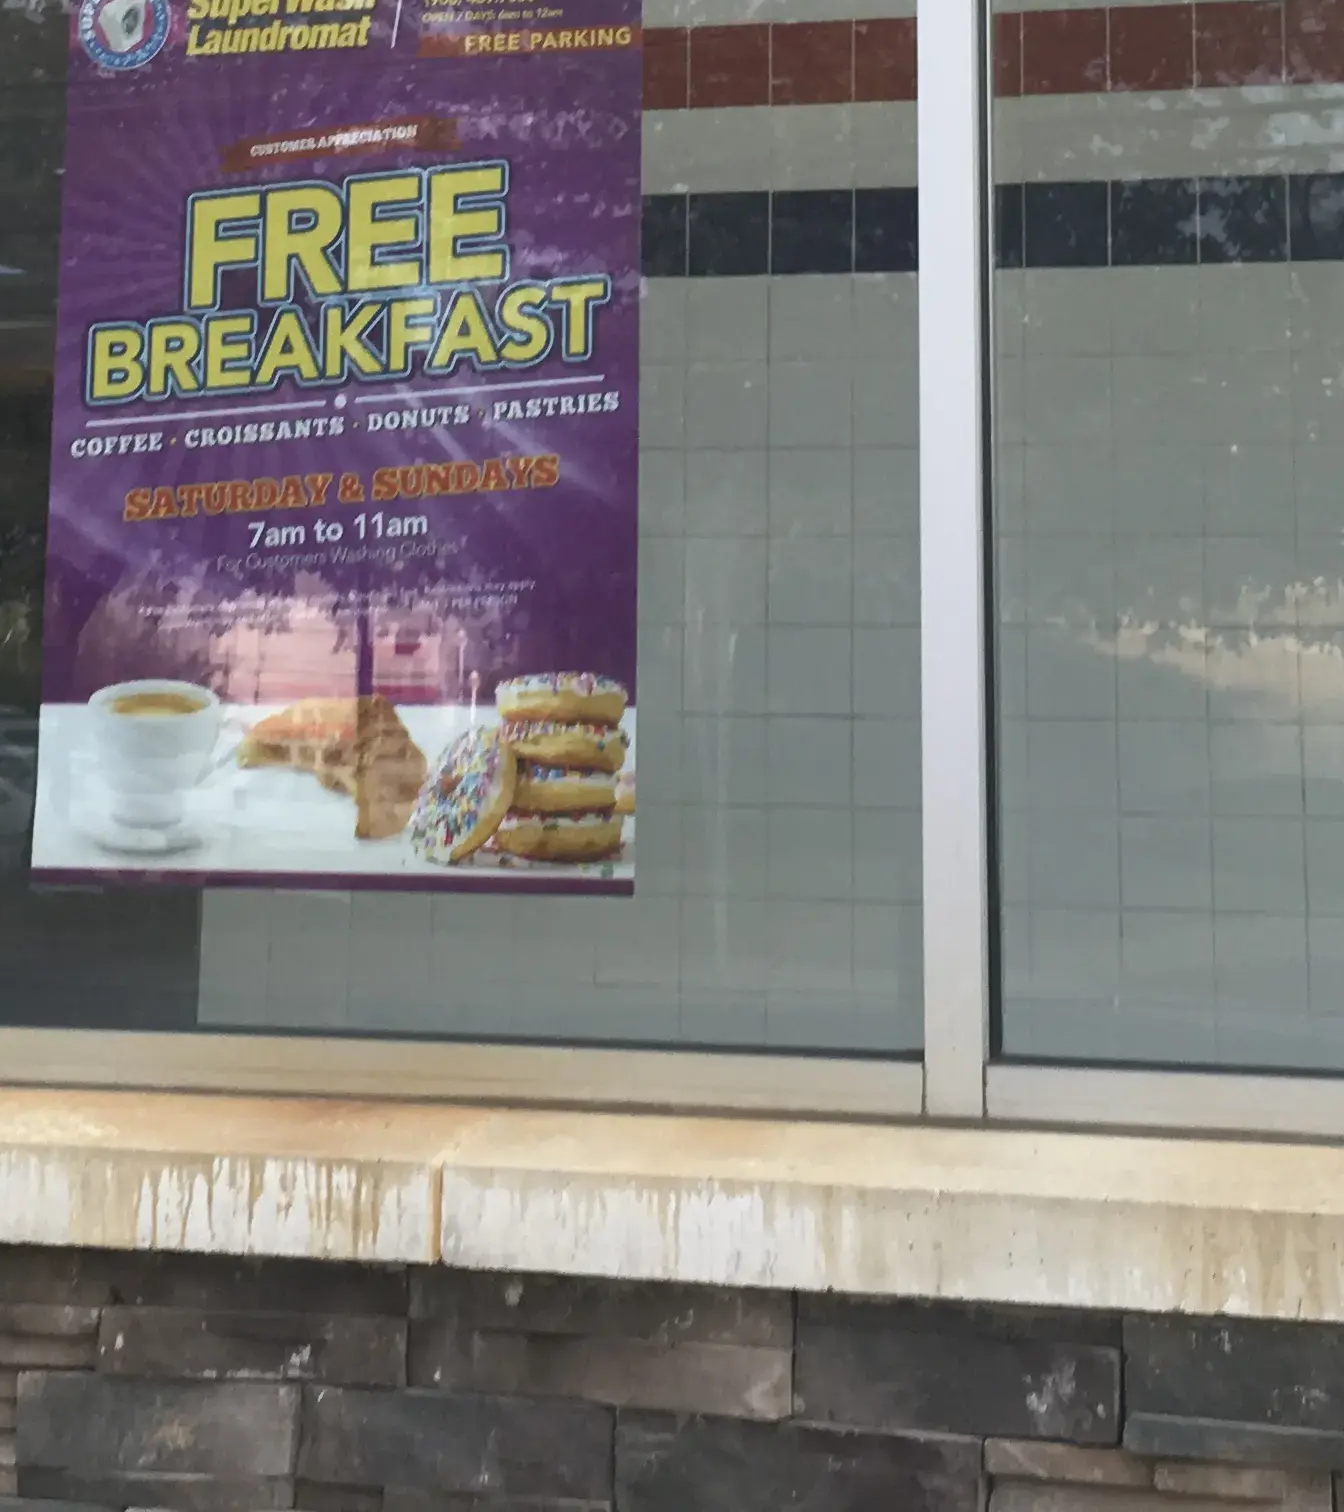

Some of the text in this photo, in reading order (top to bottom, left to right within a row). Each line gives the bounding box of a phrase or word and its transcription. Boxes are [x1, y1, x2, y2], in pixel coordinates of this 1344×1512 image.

[185, 16, 371, 56] Laundromat
[464, 26, 632, 52] FREE PARKING
[250, 124, 418, 157] CUSTOMER APPRECIATION
[186, 160, 509, 312] FREE
[86, 274, 611, 406] BREAKFAST
[71, 392, 620, 458] COFFEE CROISSANTS DONUTS PASTRIES
[124, 455, 561, 520] SATURDAY & SUNDAYS
[248, 514, 428, 548] 7am to 11am
